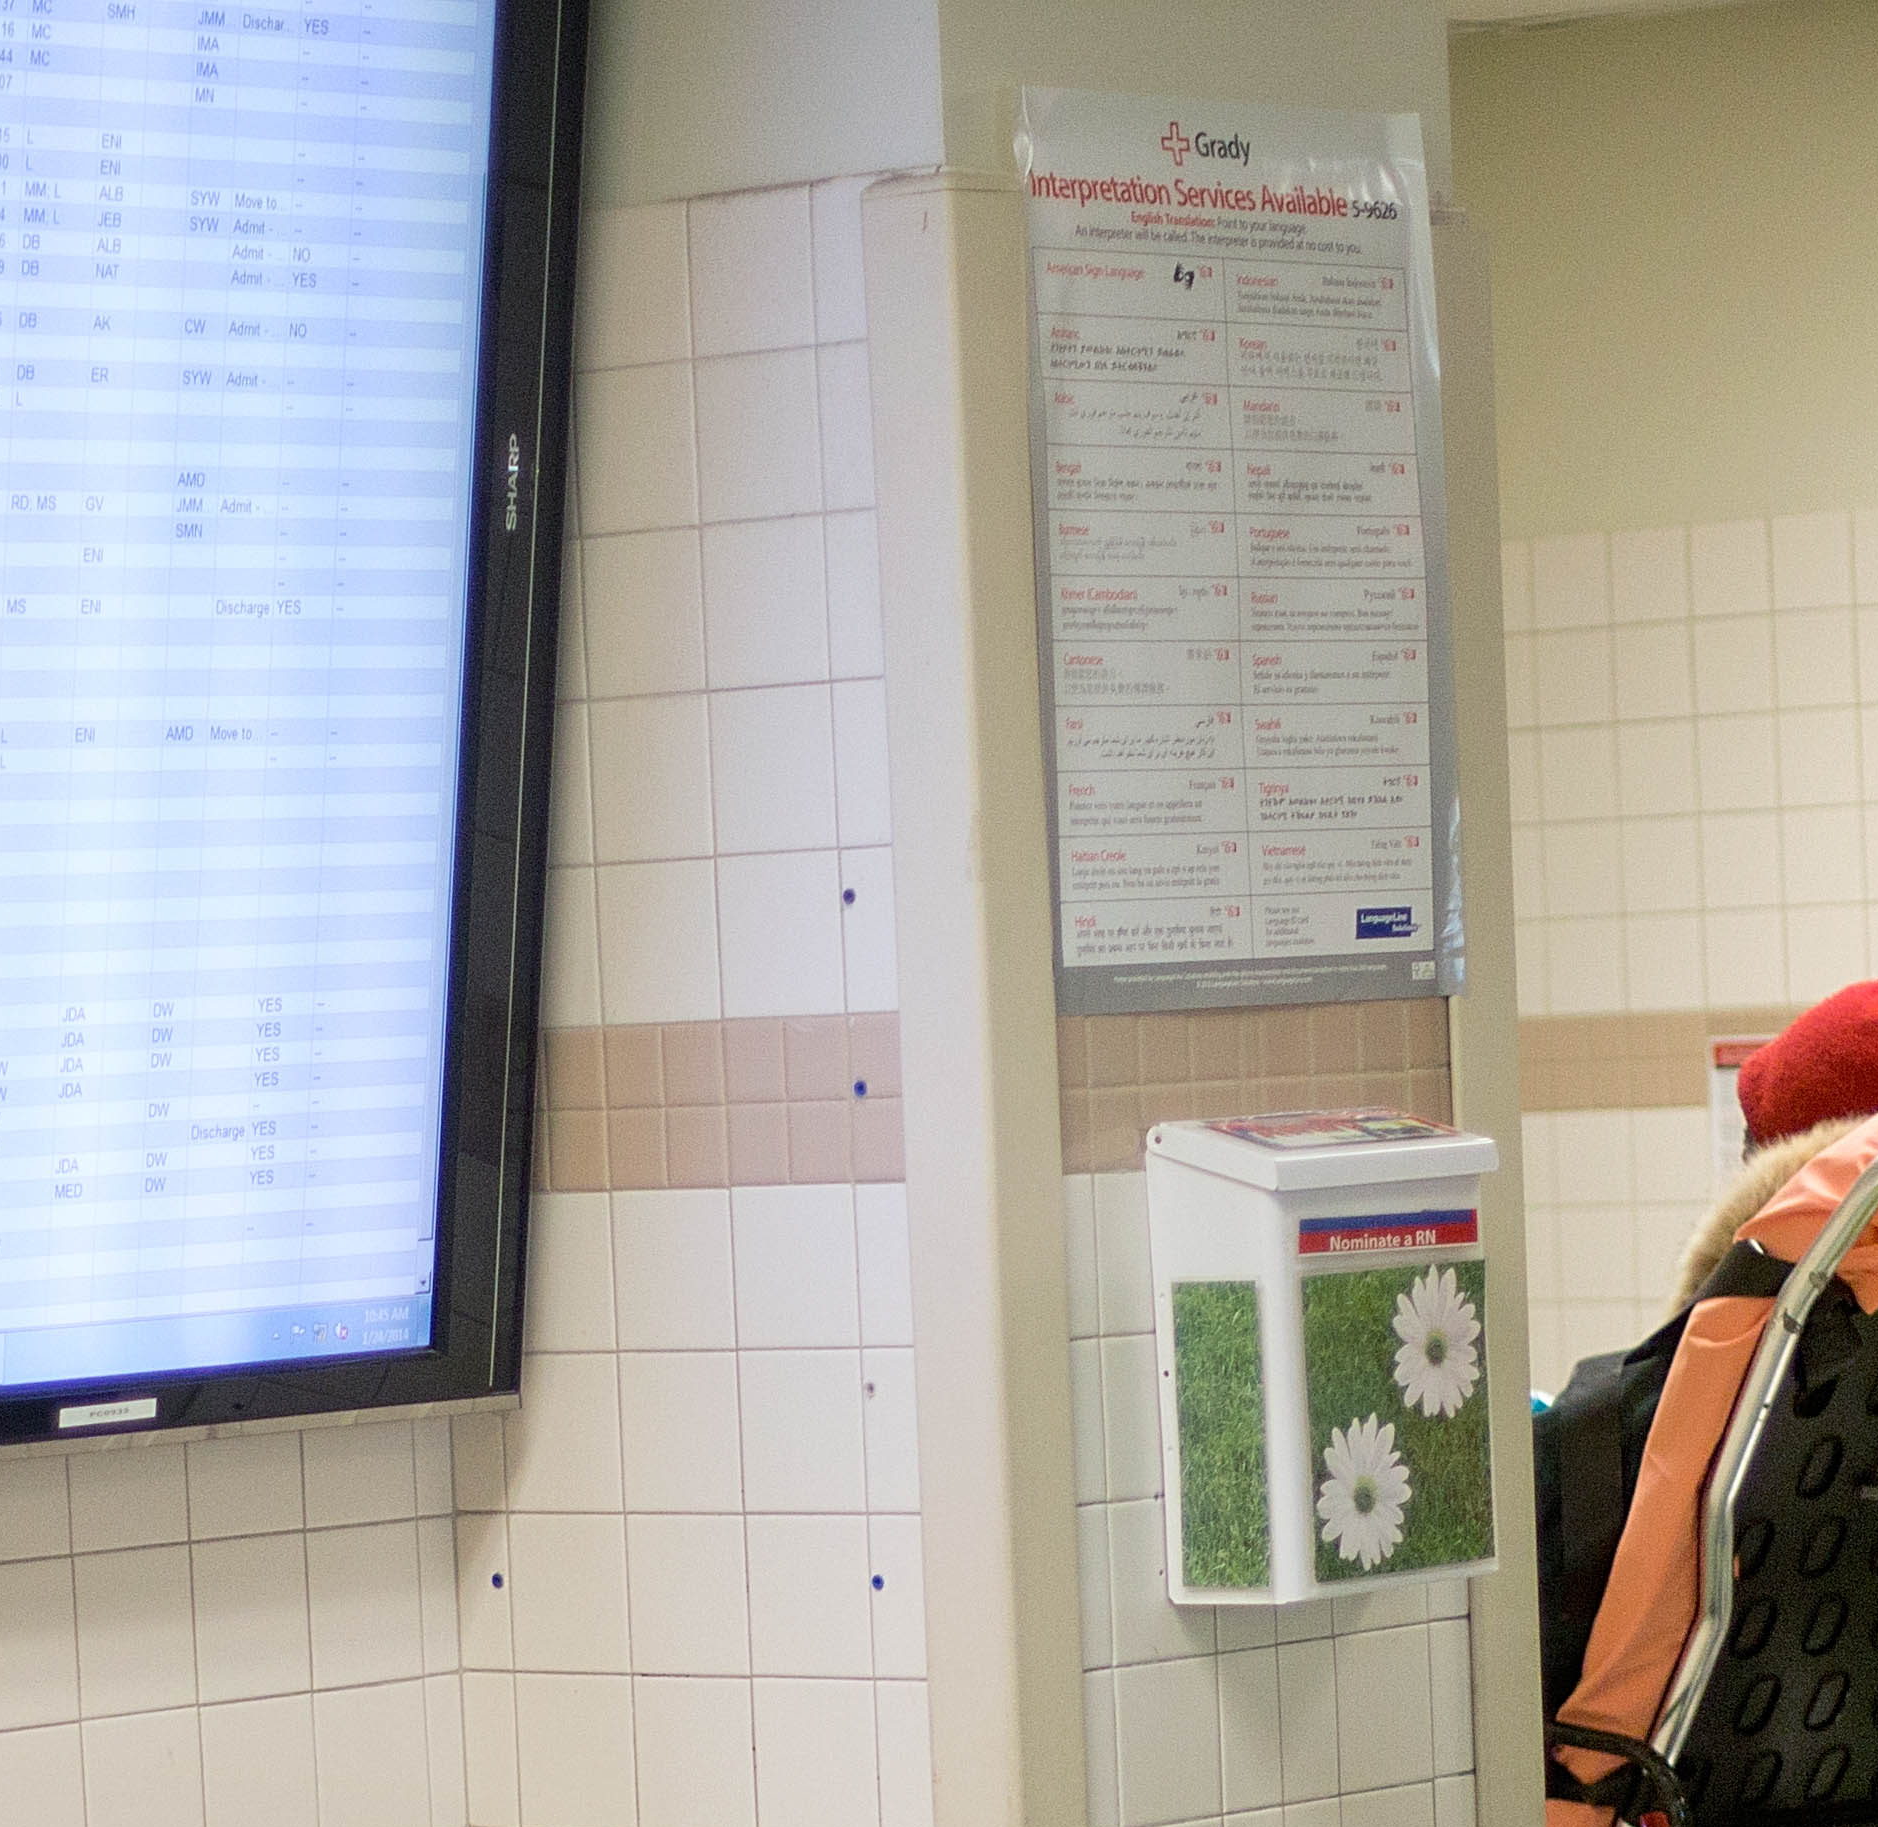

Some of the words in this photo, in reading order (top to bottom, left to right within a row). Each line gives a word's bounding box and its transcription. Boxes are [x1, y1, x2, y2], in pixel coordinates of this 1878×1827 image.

[1194, 131, 1251, 167] Grady
[1030, 171, 1172, 208] Interpretation
[1174, 178, 1257, 211] Services
[1260, 185, 1349, 218] Available
[1131, 211, 1164, 227] English
[1075, 225, 1087, 237] An
[1148, 229, 1159, 242] be
[1191, 232, 1207, 244] The
[504, 432, 520, 532] SHARP
[257, 997, 283, 1014] YES
[256, 1022, 281, 1038] YES
[191, 1123, 245, 1142] Discharge
[252, 1120, 277, 1137] YES
[1329, 1233, 1402, 1252] Nominate
[1404, 1235, 1412, 1247] a
[1415, 1229, 1437, 1247] RN
